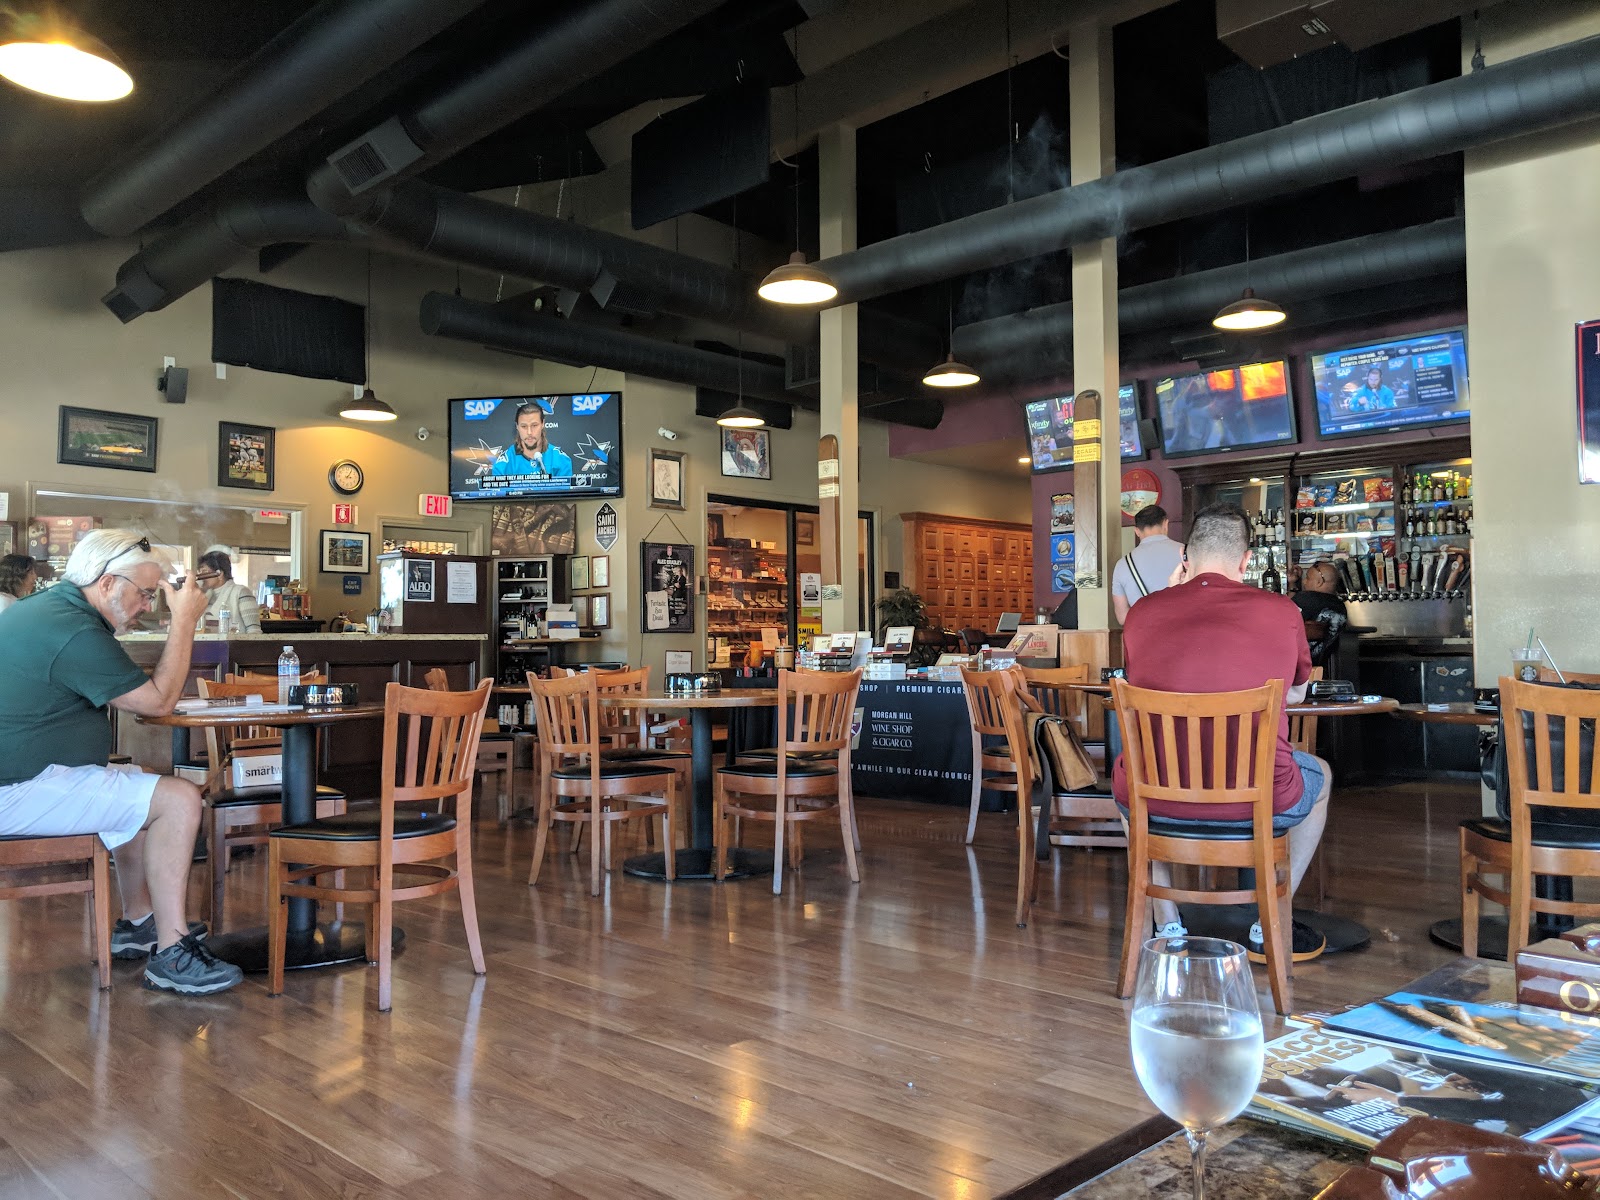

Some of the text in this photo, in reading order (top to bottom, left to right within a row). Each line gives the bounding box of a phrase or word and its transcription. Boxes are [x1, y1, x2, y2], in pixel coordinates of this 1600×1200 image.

[1336, 368, 1351, 377] SAP
[465, 401, 495, 416] SAP
[572, 396, 604, 412] SAP
[1031, 420, 1050, 429] xfinity
[426, 495, 448, 516] EXIT
[598, 514, 615, 526] SAINT
[598, 526, 616, 535] ARCHER
[798, 627, 815, 635] SMILE
[860, 684, 878, 692] SHOP
[896, 685, 933, 694] PREMIUM
[871, 711, 912, 720] MORGAN HILL
[871, 723, 913, 734] WINE SHOP
[872, 737, 913, 748] & CIGAR CO.
[856, 763, 882, 772] AWHILE
[886, 766, 893, 774] IN
[897, 767, 911, 775] OUR
[914, 769, 939, 778] CIGAR
[941, 771, 972, 781] LOUNGE
[1260, 1039, 1378, 1084] USINES
[1322, 1097, 1400, 1122] DAVIDOFF
